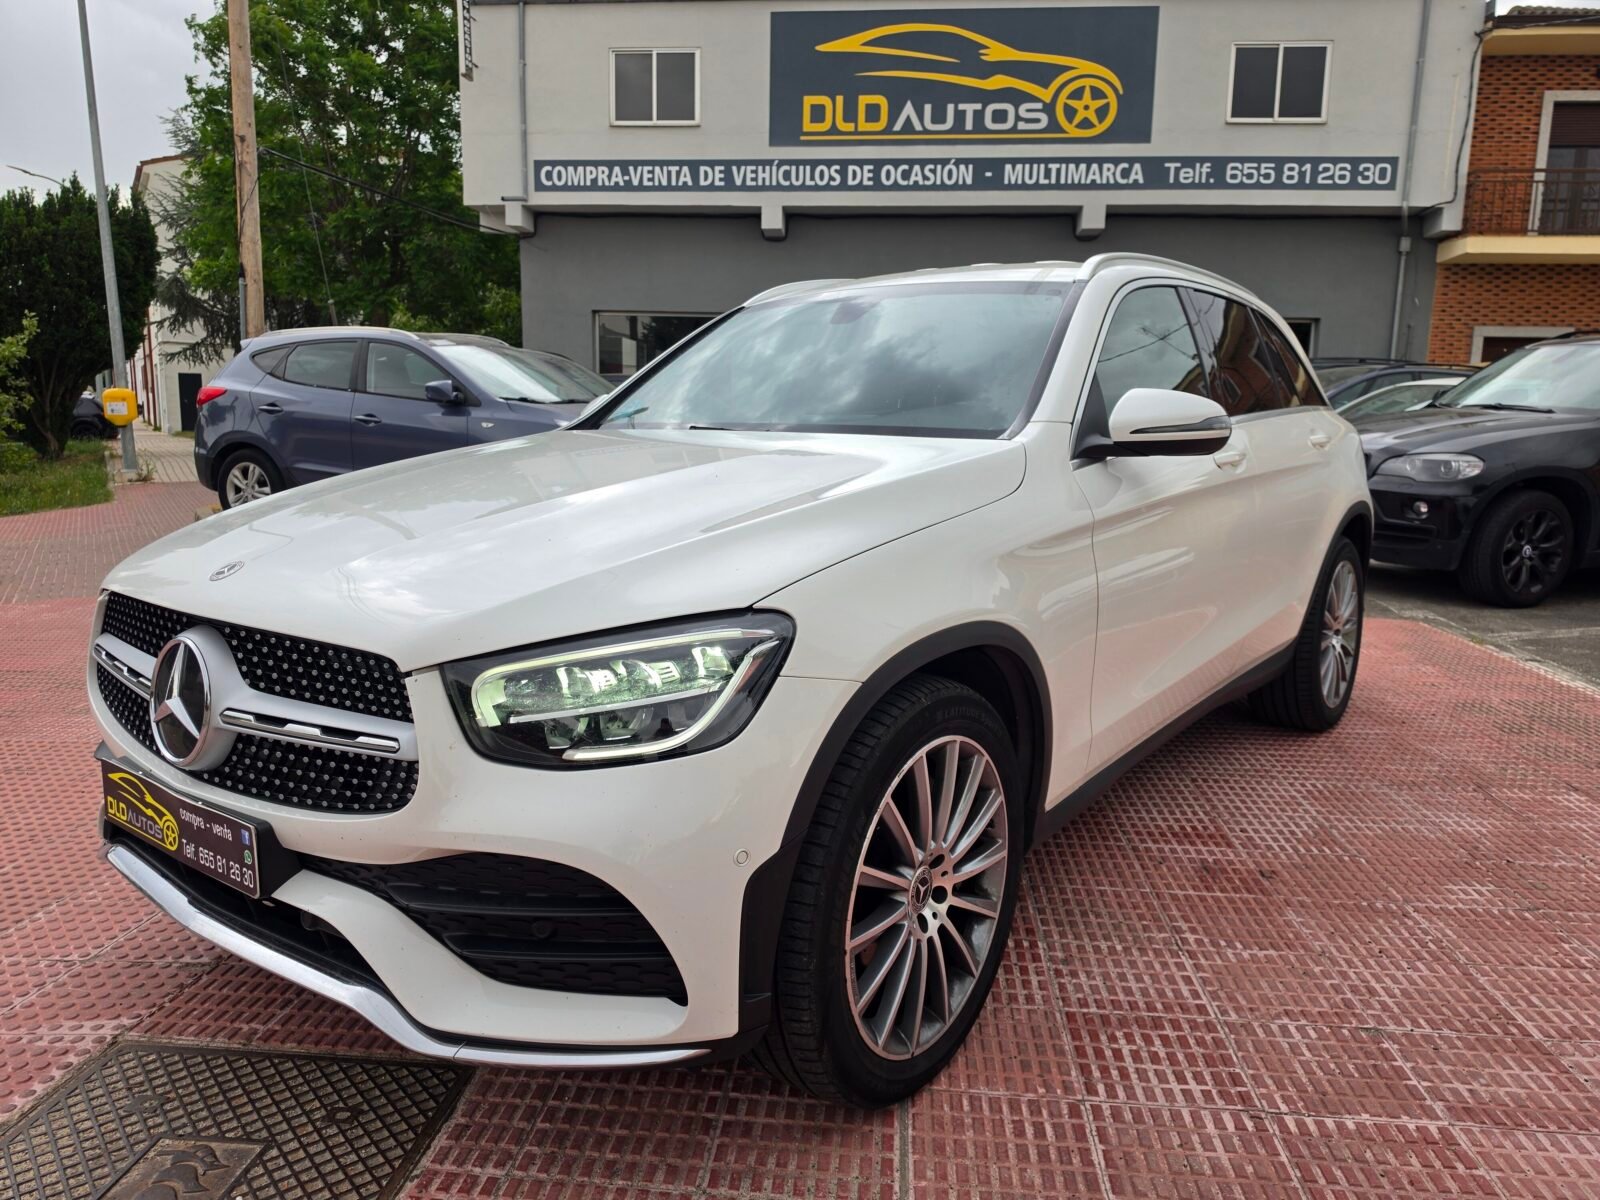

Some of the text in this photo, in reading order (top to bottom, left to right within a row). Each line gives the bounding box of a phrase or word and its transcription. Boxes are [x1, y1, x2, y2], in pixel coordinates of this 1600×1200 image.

[803, 95, 1049, 131] DLD AUTOS
[540, 165, 693, 186] COMPRA-VENTA
[699, 165, 725, 186] DE
[732, 160, 841, 186] VEHÍCULOS
[847, 165, 874, 185] DE
[880, 159, 974, 185] OCASIÓN
[1003, 163, 1144, 185] MULTIMARCA
[1164, 162, 1215, 184] Telf.
[1225, 162, 1276, 184] 655
[1357, 162, 1392, 184] 30
[107, 795, 163, 839] DLD AUTOS
[179, 808, 205, 830] compra
[211, 822, 233, 841] venta
[181, 838, 254, 888] Telf. 655 81 26 30
